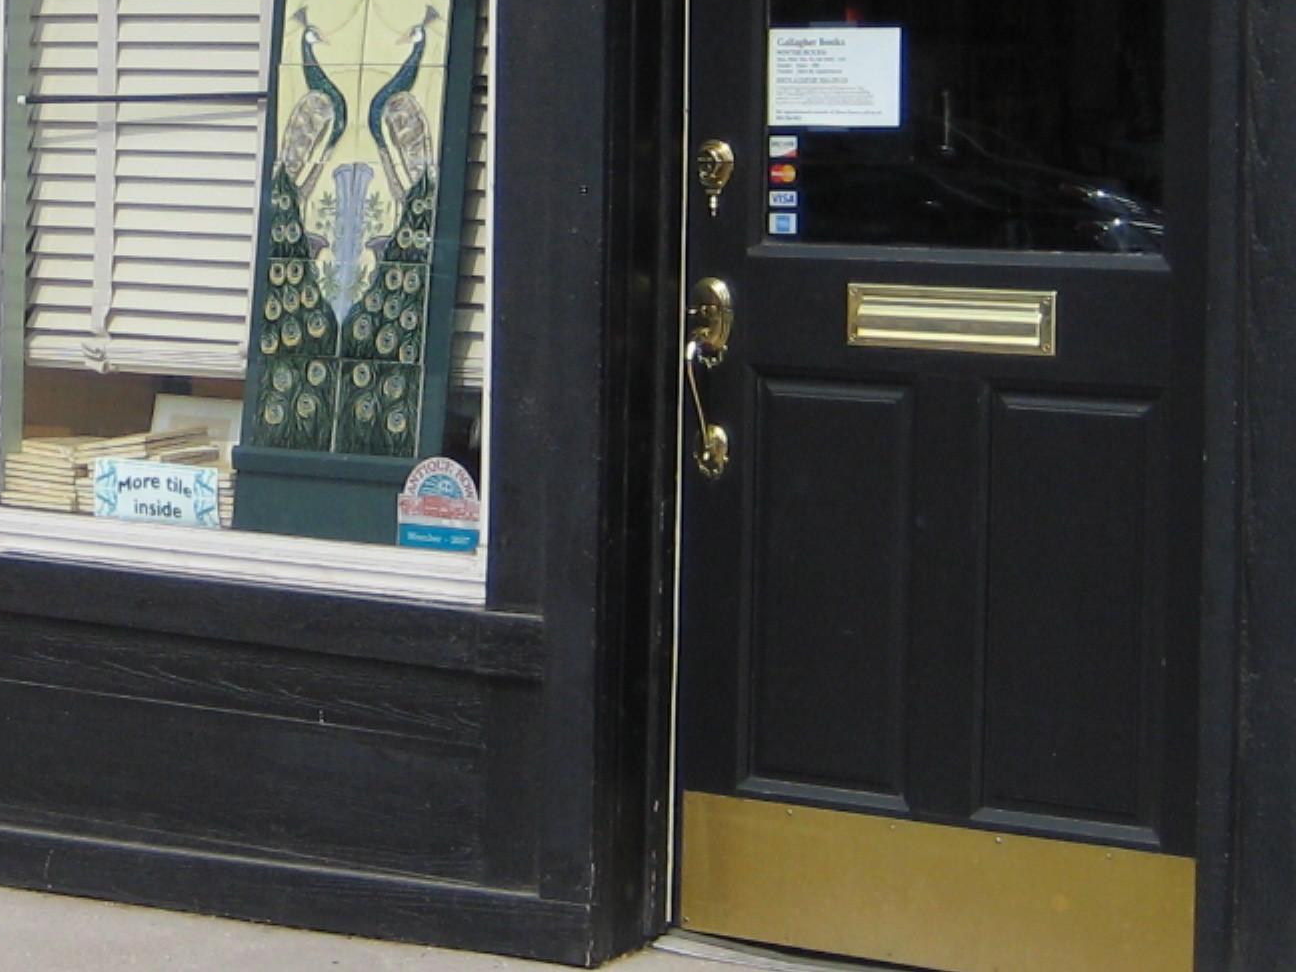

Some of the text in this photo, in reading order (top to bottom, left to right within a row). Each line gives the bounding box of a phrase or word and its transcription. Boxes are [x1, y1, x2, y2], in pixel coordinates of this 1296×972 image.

[776, 36, 846, 48] Gallagher Books
[772, 194, 794, 203] VISA
[118, 475, 192, 498] More tile
[134, 498, 182, 518] inside
